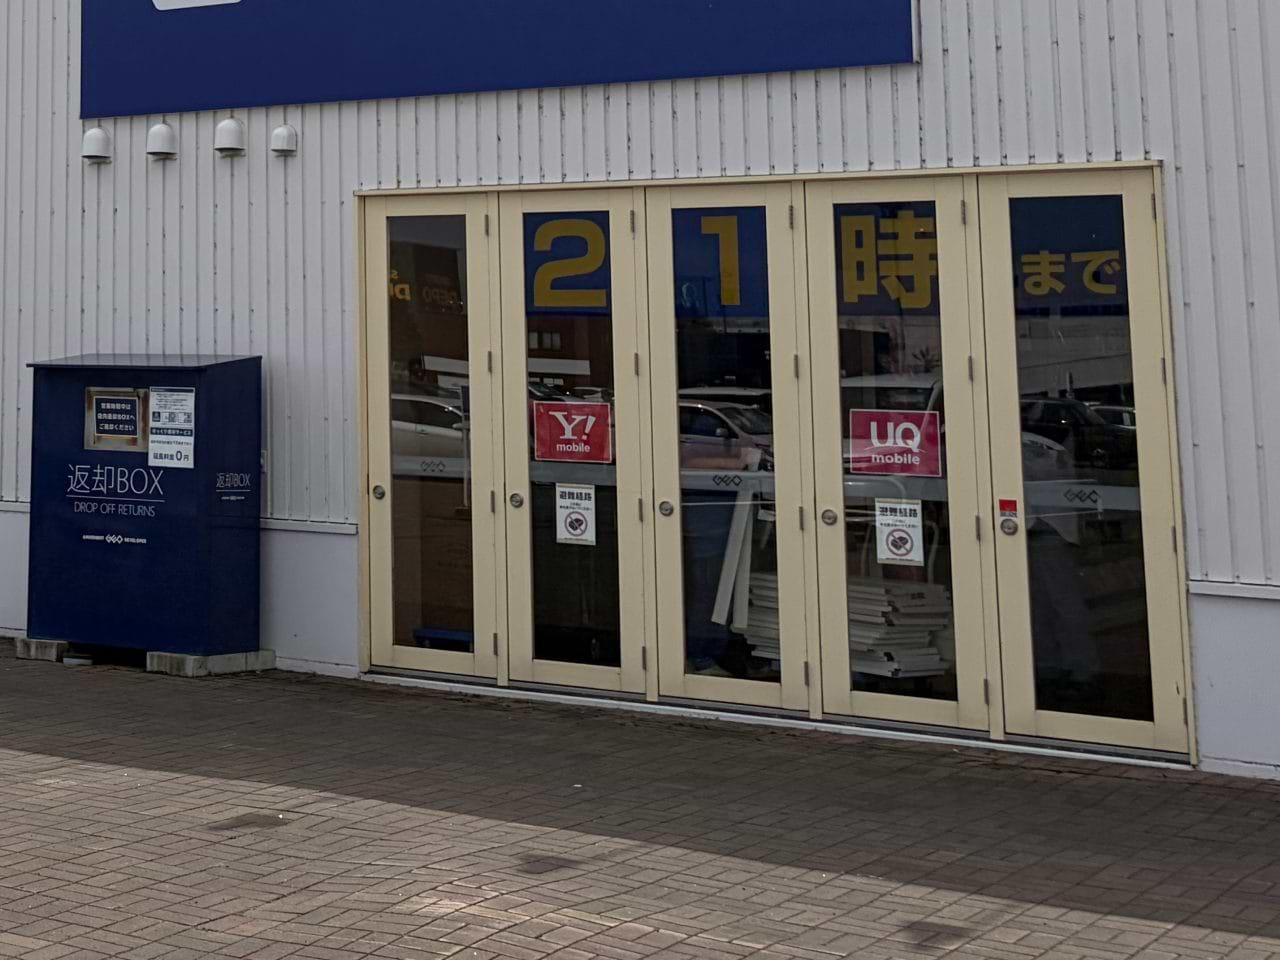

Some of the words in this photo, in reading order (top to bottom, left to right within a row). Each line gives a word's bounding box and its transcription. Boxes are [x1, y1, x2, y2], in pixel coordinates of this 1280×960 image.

[548, 411, 596, 440] Y!
[870, 421, 921, 452] UQ
[556, 442, 591, 453] mobile
[871, 453, 921, 465] mobile
[67, 464, 165, 495] 返却BOX
[74, 501, 98, 513] DROP
[100, 503, 116, 515] OFF
[118, 504, 156, 517] RETURNS
